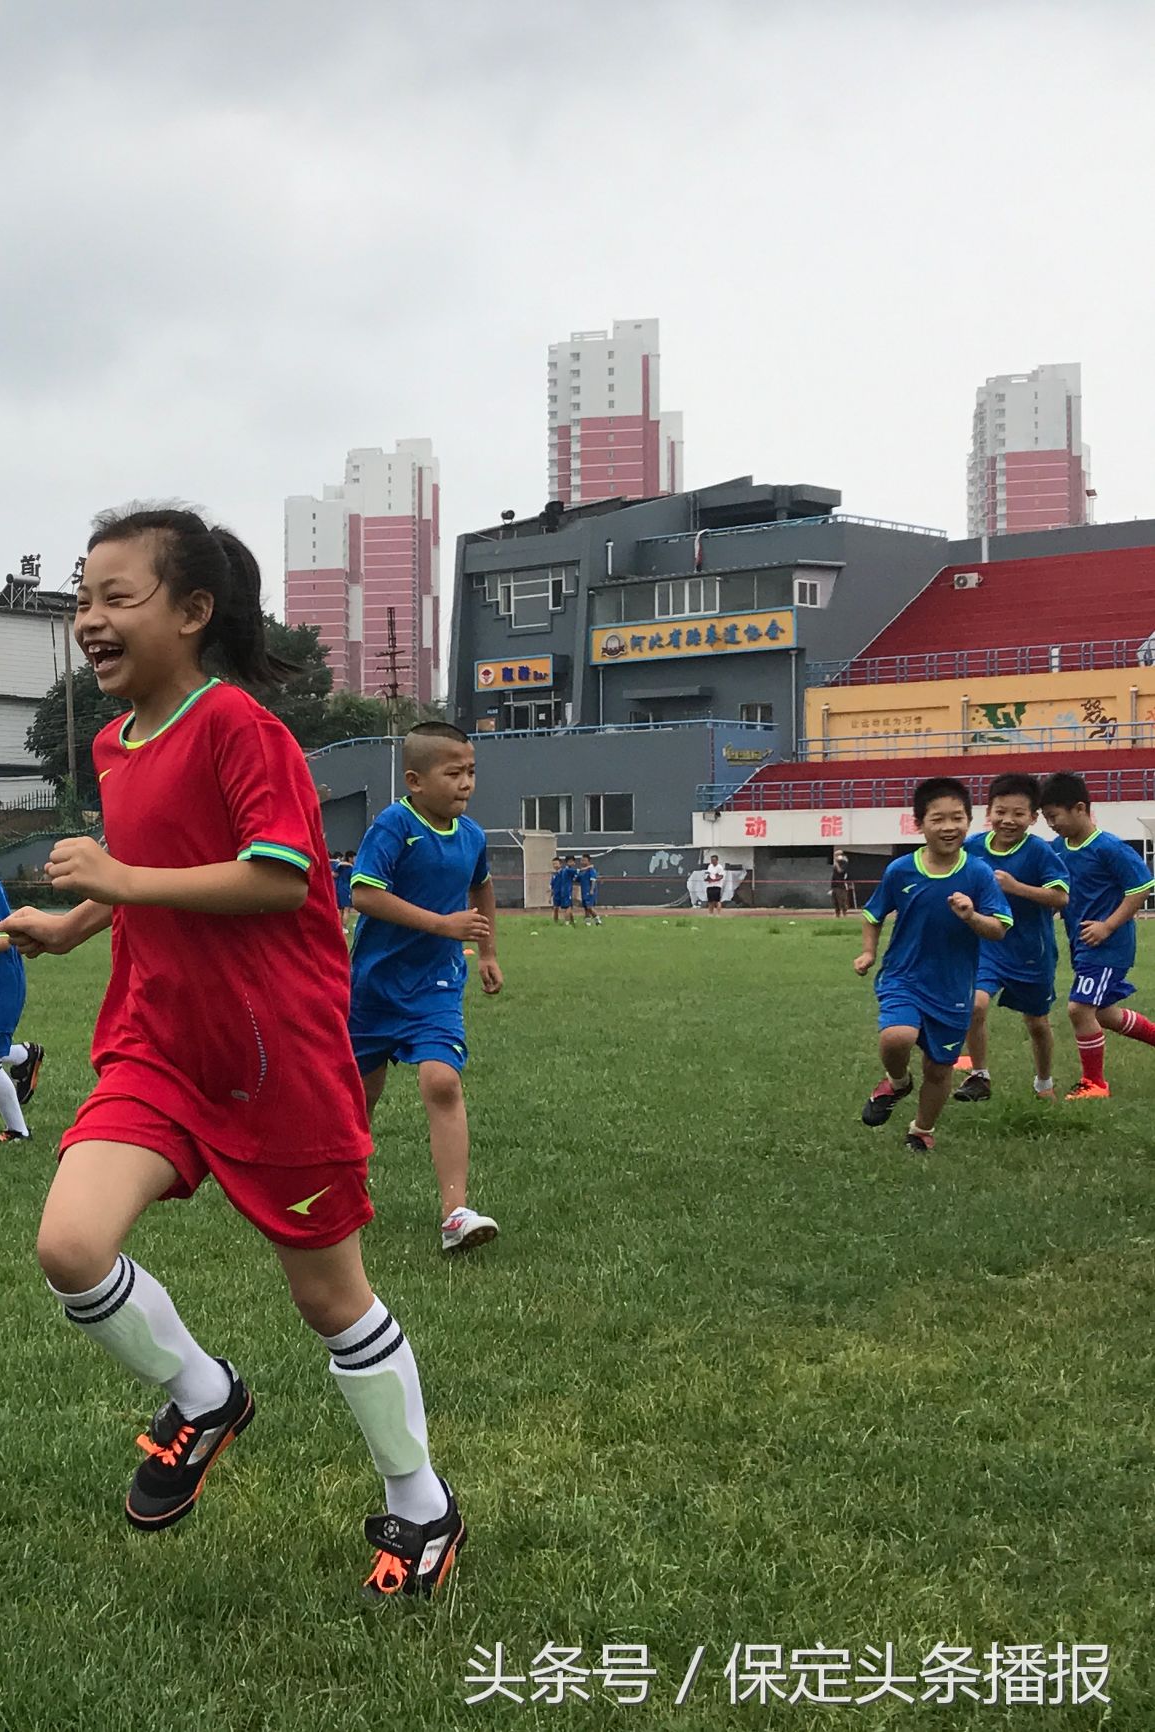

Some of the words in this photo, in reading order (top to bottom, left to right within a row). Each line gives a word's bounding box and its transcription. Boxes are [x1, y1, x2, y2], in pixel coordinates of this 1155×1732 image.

[630, 619, 786, 653] 河北省跆拳道协会
[1075, 974, 1095, 995] 10
